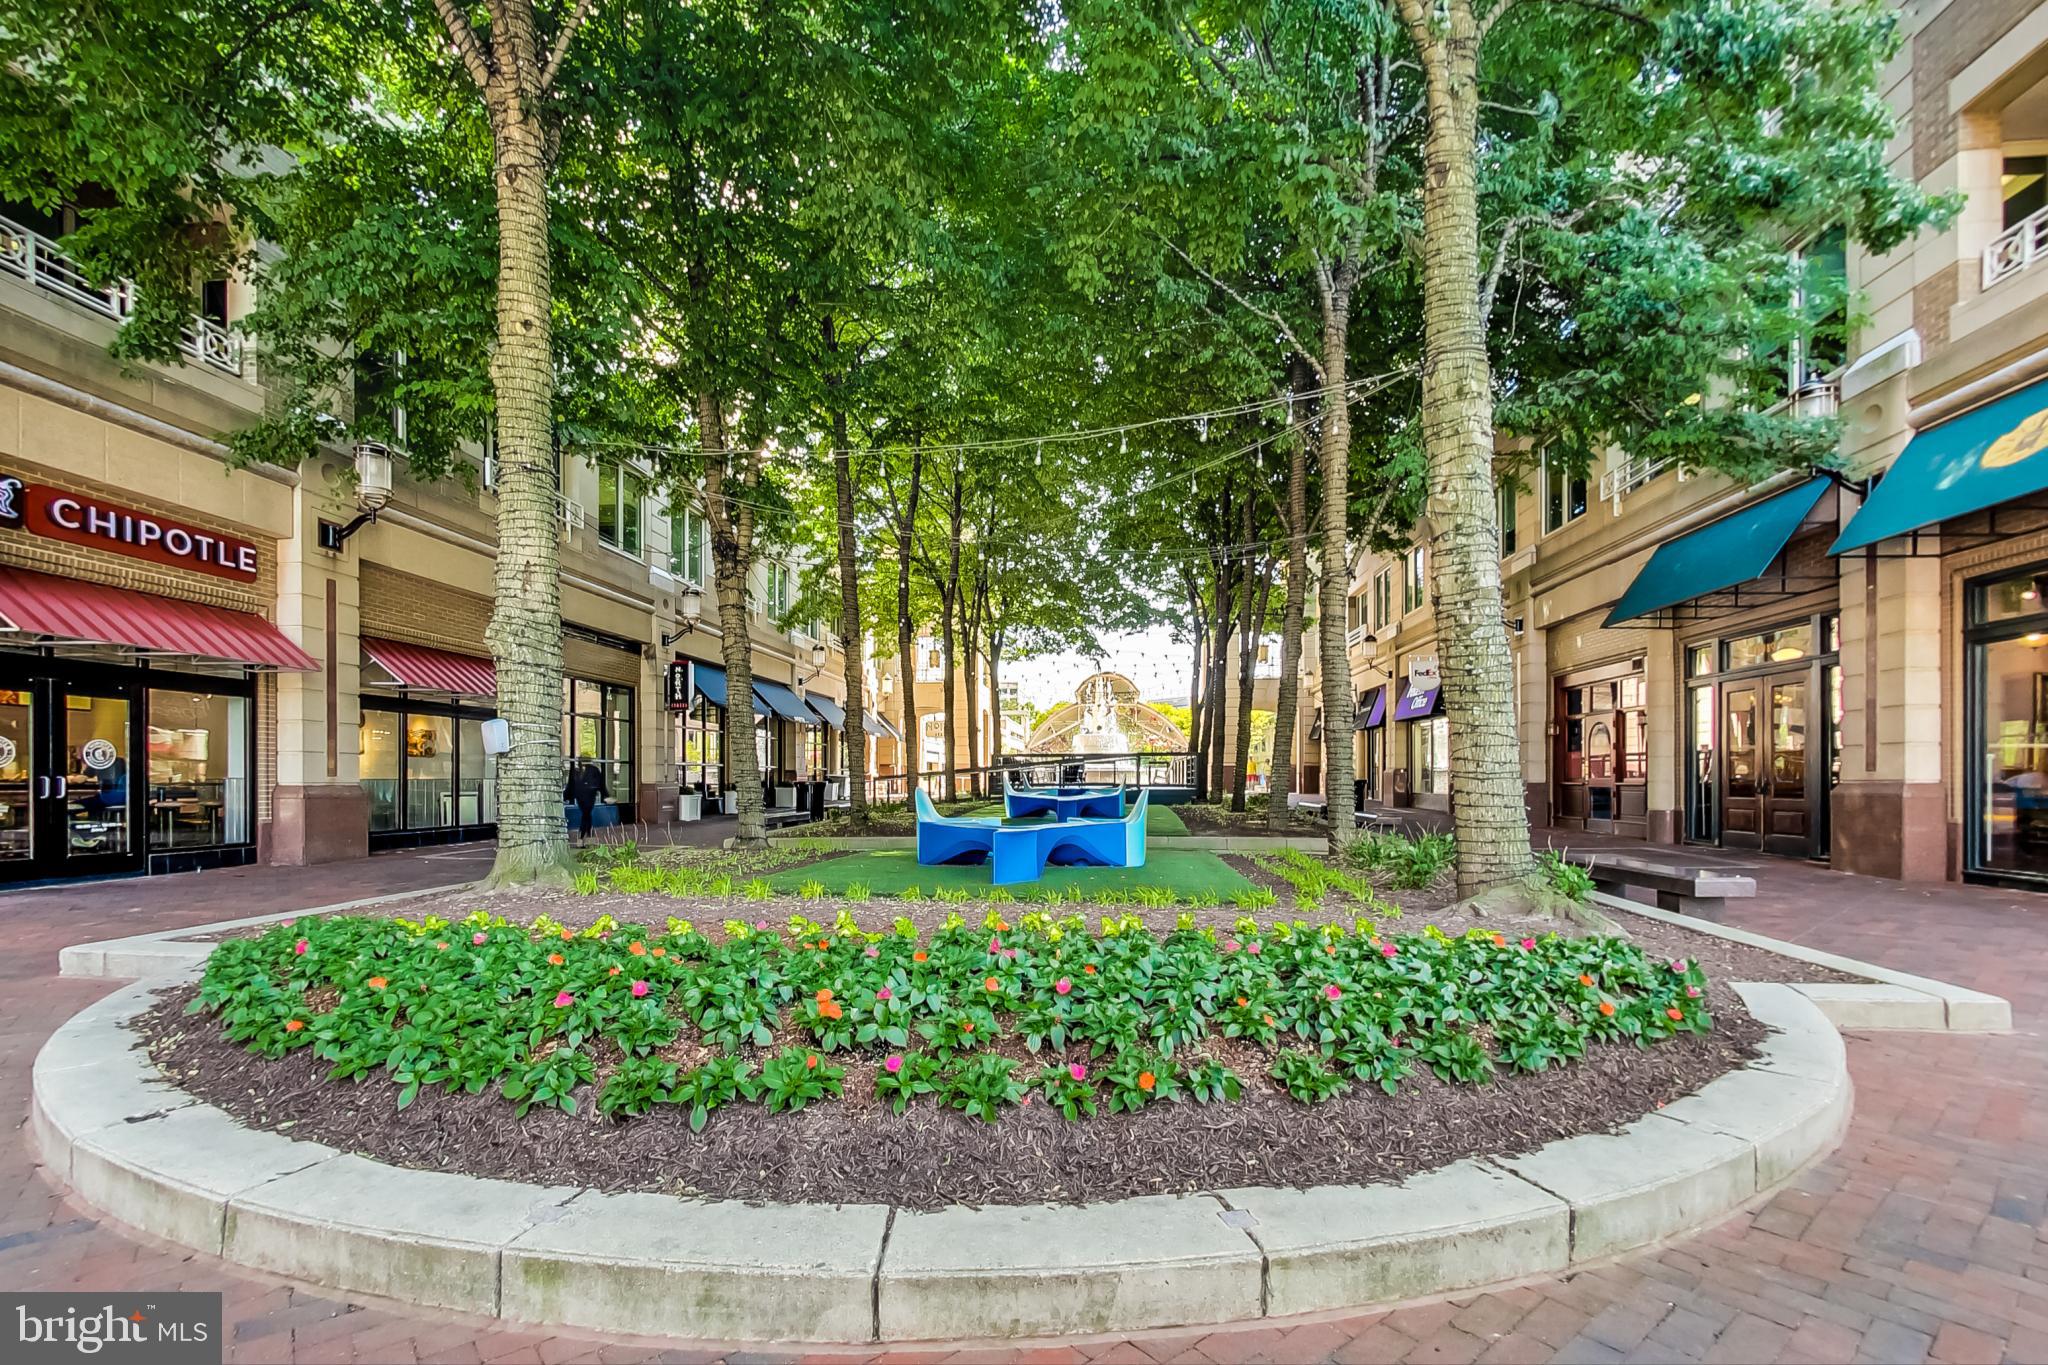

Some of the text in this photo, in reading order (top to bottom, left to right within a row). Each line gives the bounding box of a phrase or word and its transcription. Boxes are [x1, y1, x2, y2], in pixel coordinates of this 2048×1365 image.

[52, 498, 257, 573] CHIPOTLE
[674, 666, 683, 700] NORTH
[1414, 668, 1437, 677] FedEx
